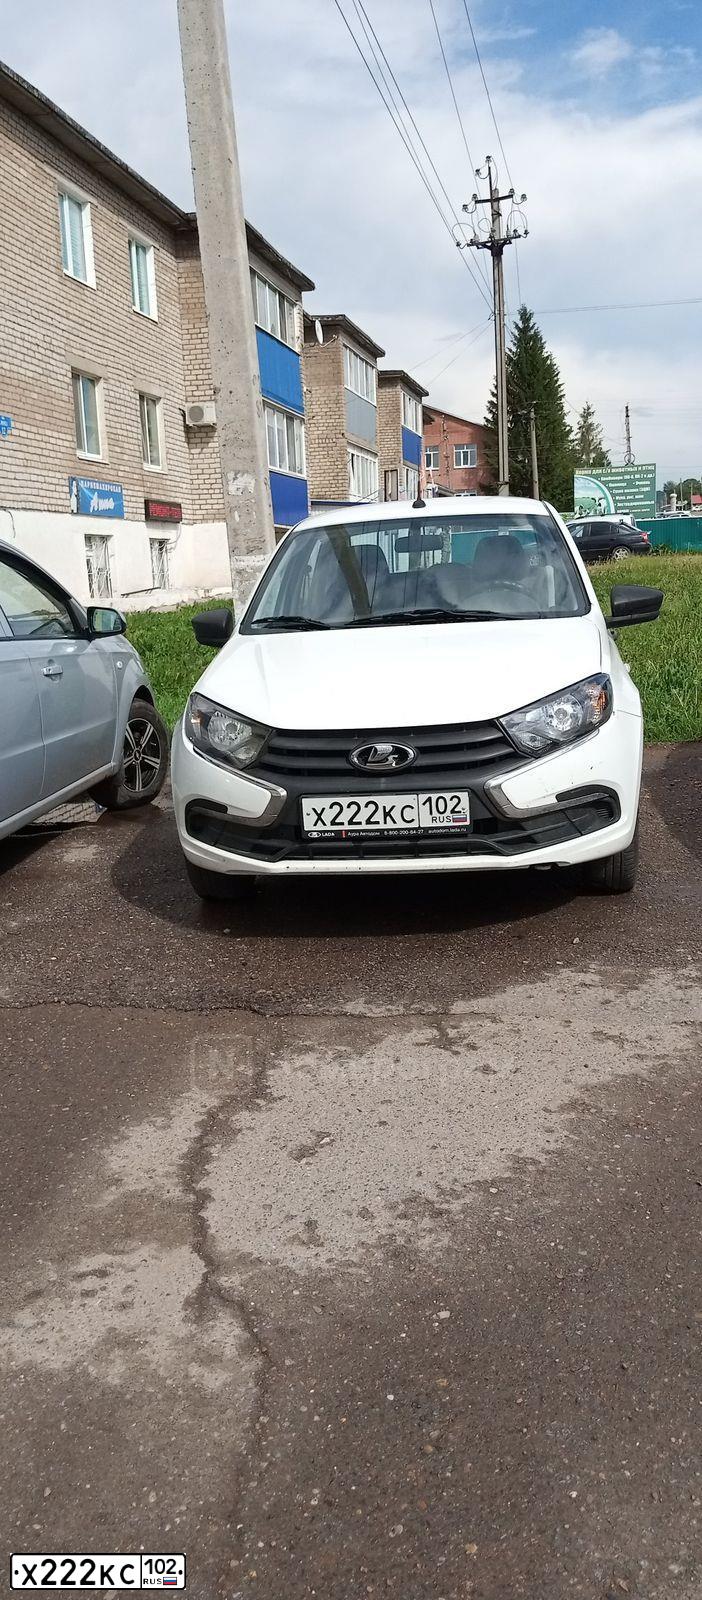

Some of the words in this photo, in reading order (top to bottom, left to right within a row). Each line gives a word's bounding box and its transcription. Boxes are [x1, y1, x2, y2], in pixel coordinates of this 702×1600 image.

[311, 800, 415, 827] Х222КС
[422, 795, 461, 816] 102
[431, 815, 452, 824] RUS
